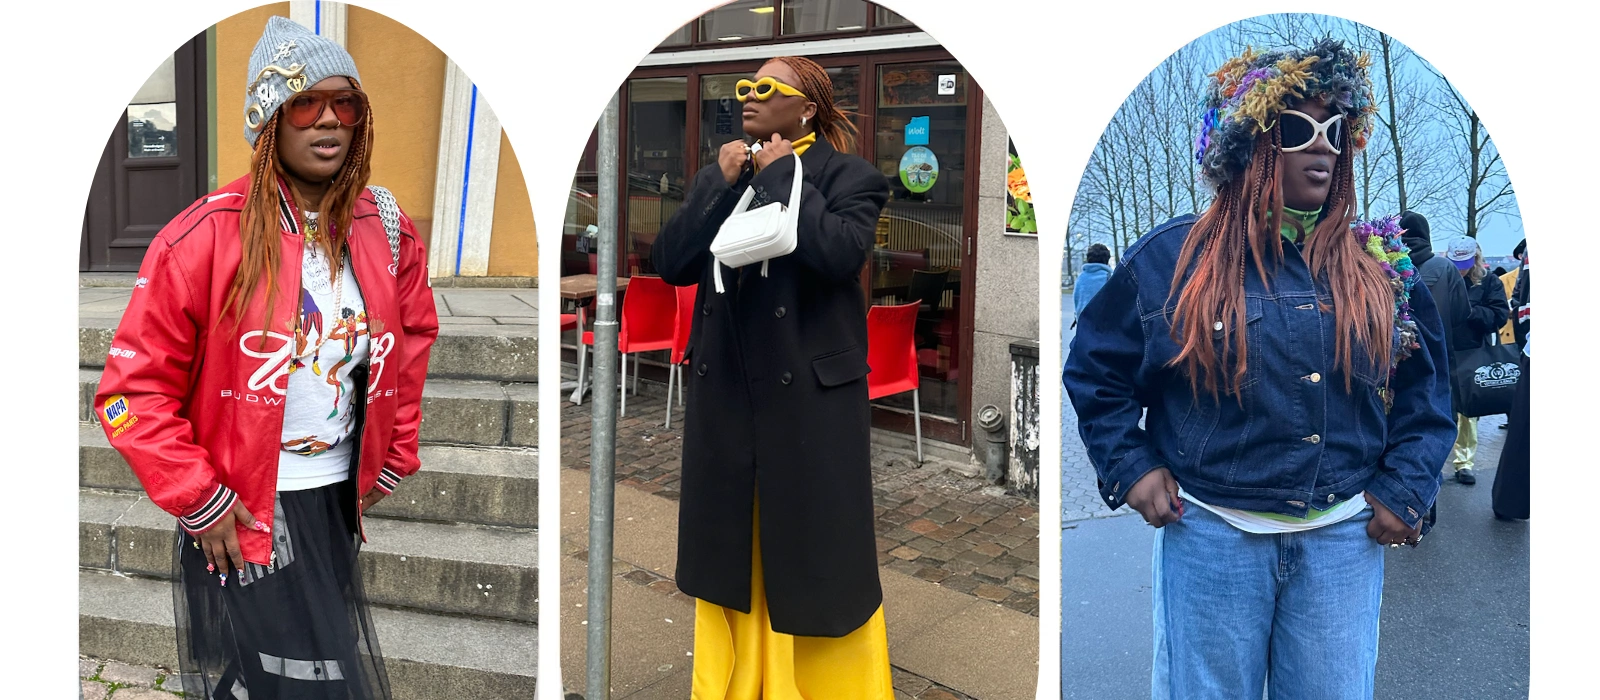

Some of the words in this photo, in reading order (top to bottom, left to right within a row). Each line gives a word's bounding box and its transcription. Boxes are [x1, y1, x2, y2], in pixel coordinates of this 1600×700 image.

[908, 127, 925, 135] Wolt
[106, 398, 127, 421] NAPA
[111, 426, 124, 438] AUTO
[122, 415, 139, 430] PARTS
